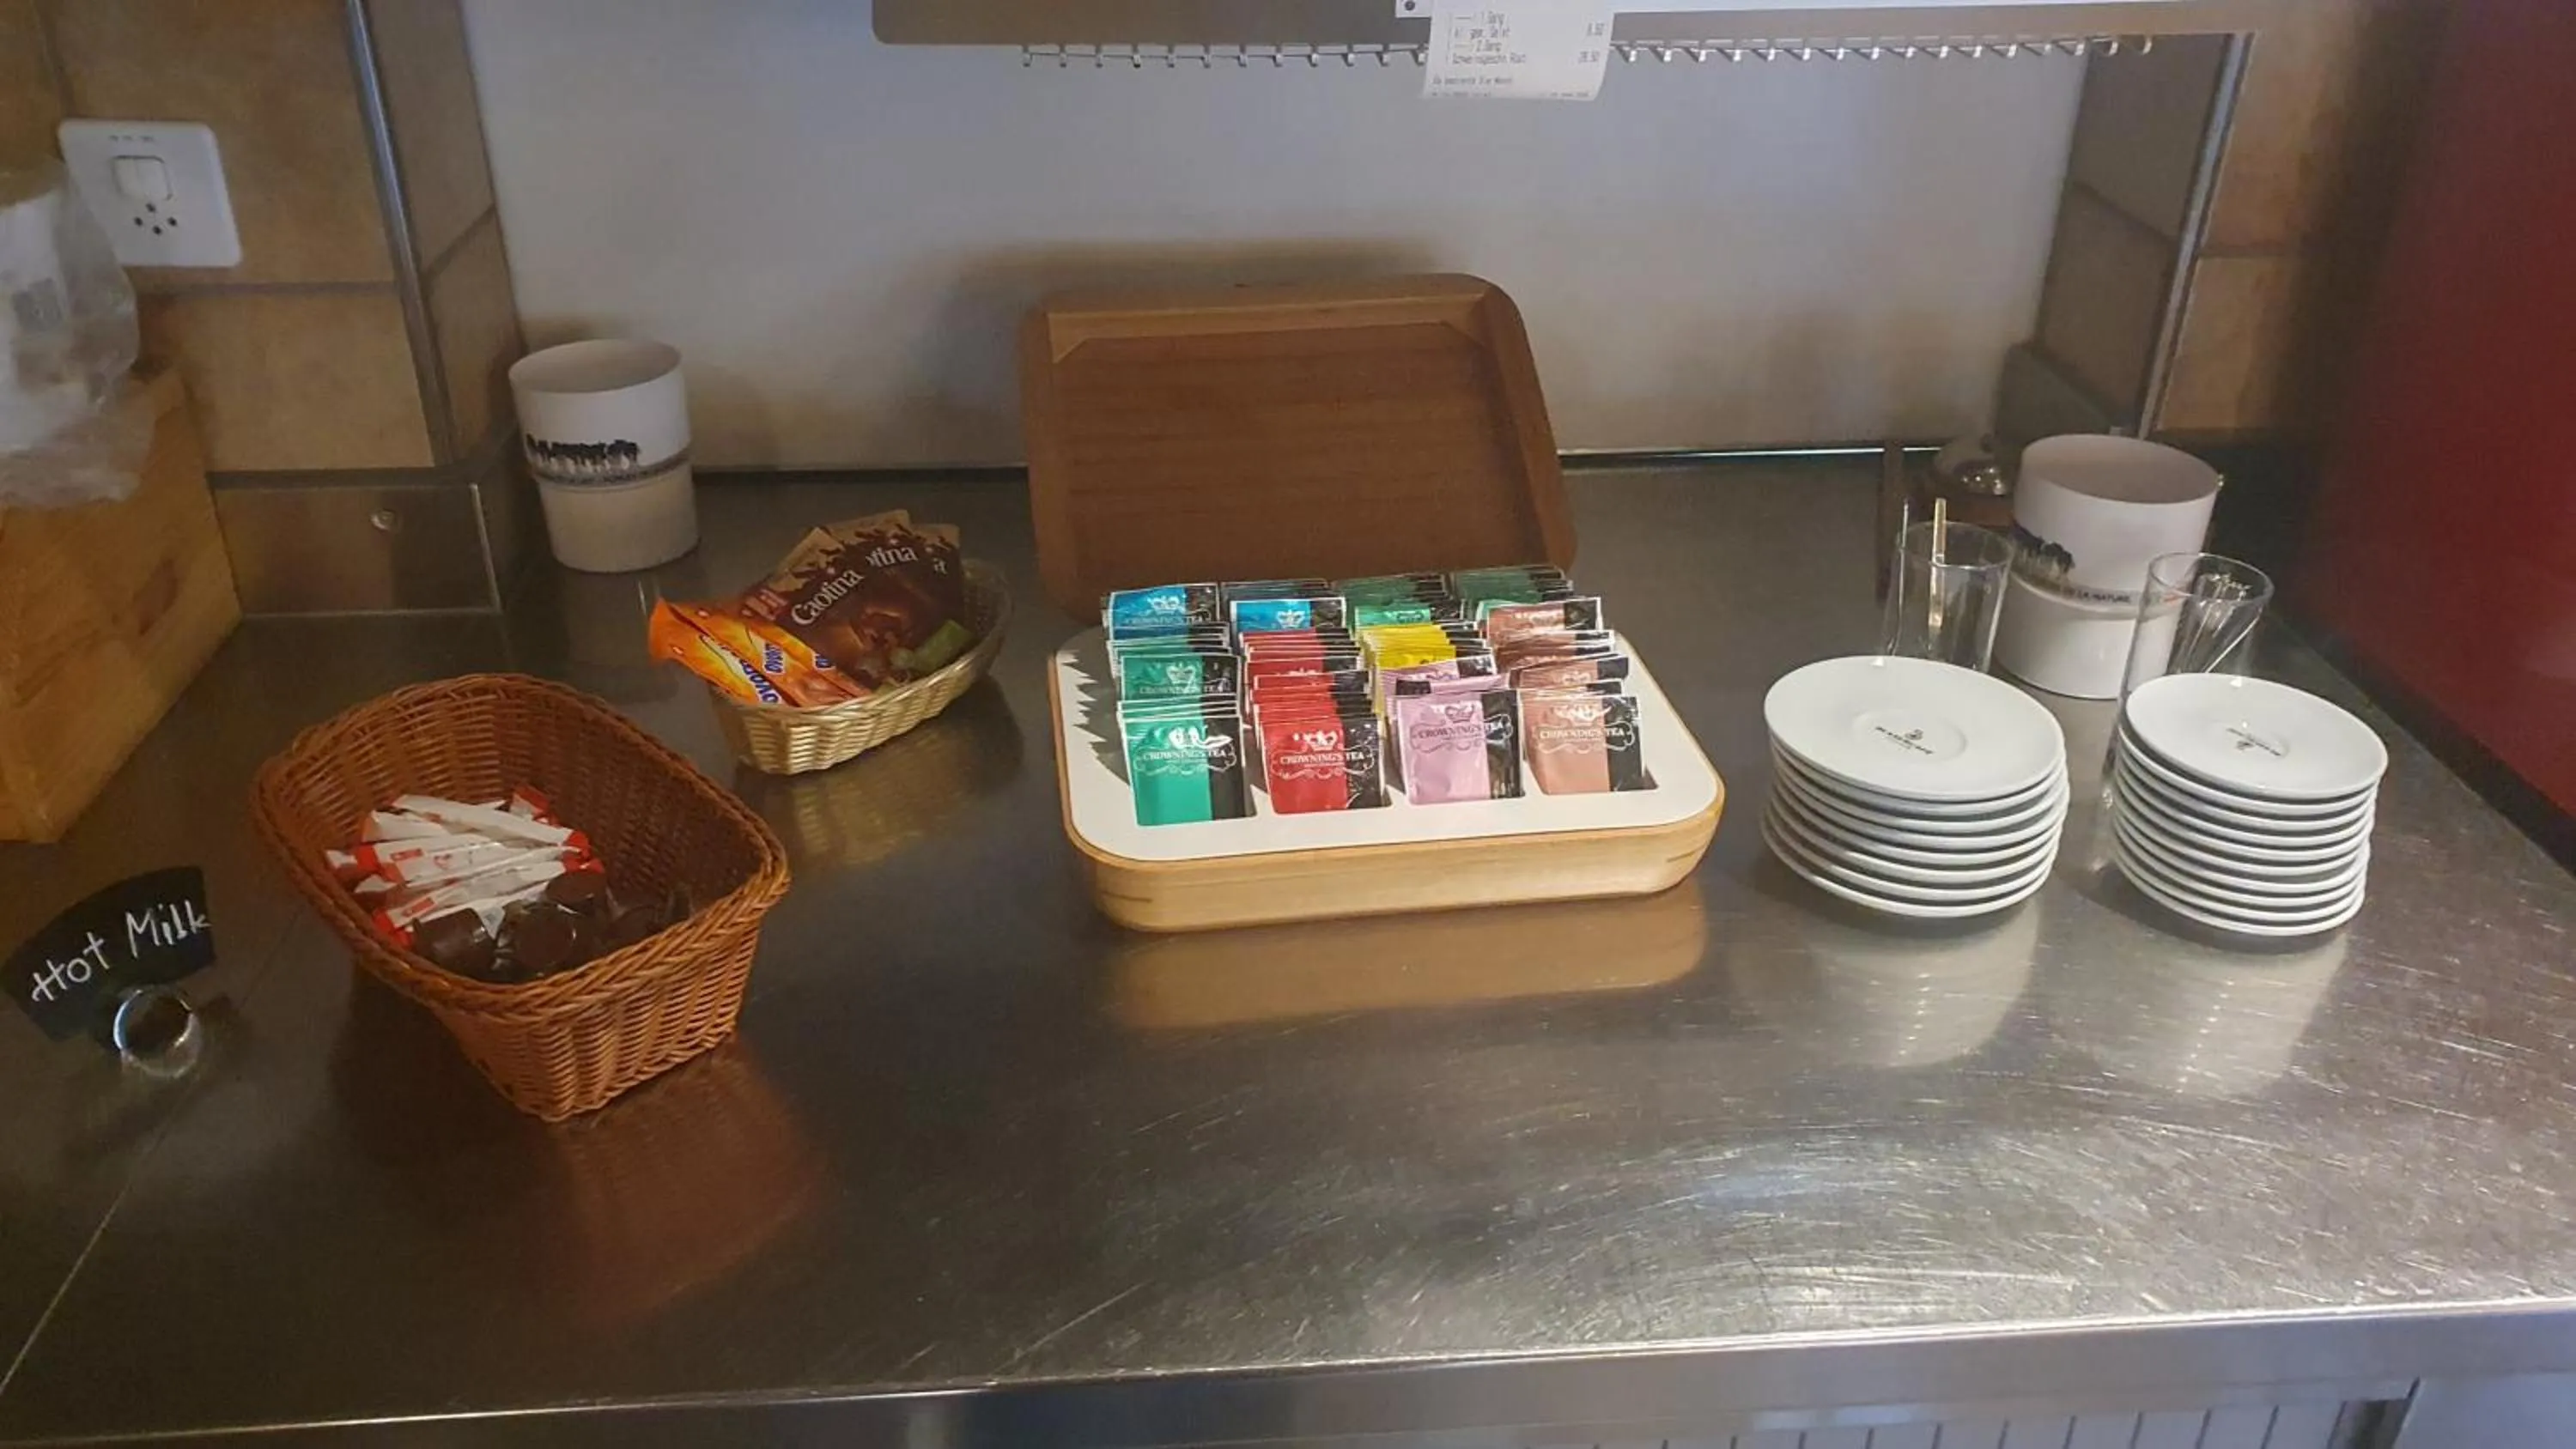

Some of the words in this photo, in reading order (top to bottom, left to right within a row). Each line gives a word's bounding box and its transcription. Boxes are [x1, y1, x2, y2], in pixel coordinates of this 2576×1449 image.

[790, 567, 865, 627] Caotina
[1606, 727, 1625, 737] TEA
[1346, 750, 1365, 761] TEA
[31, 931, 110, 1003] Hot
[125, 899, 212, 959] Milk
